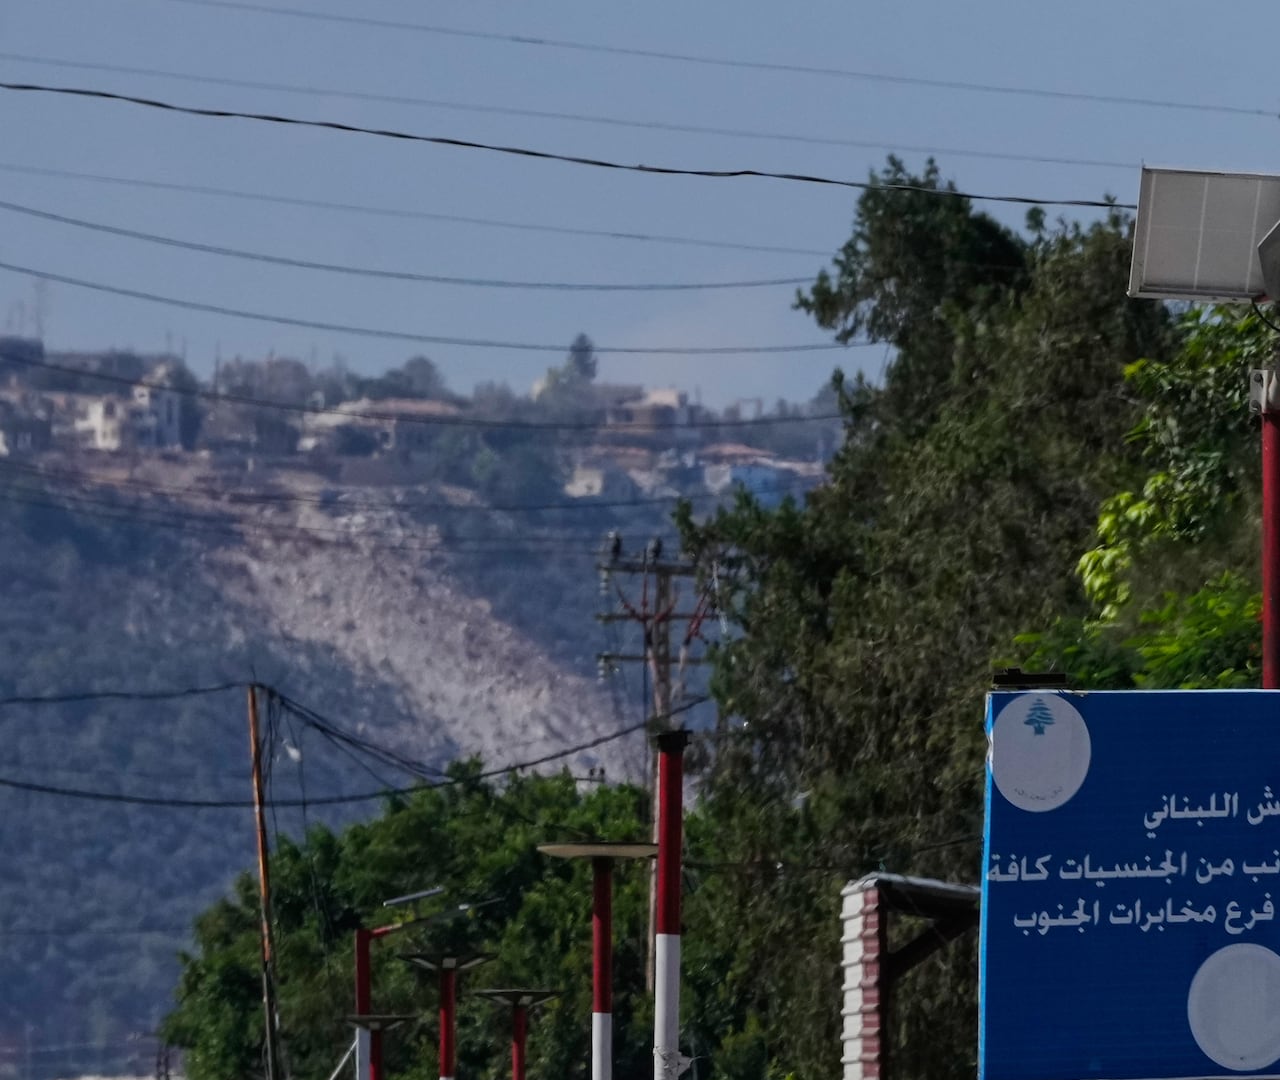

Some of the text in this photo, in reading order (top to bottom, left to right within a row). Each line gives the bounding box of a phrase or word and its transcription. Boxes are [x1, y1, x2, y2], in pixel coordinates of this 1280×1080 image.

[1144, 792, 1238, 839] اللبناني
[988, 855, 1050, 882] كافة
[1059, 850, 1188, 888] الجنسيات
[1195, 856, 1233, 883] من
[1013, 898, 1099, 935] الجنوب
[1109, 898, 1215, 932] مخابرات
[1224, 894, 1273, 934] فرع
